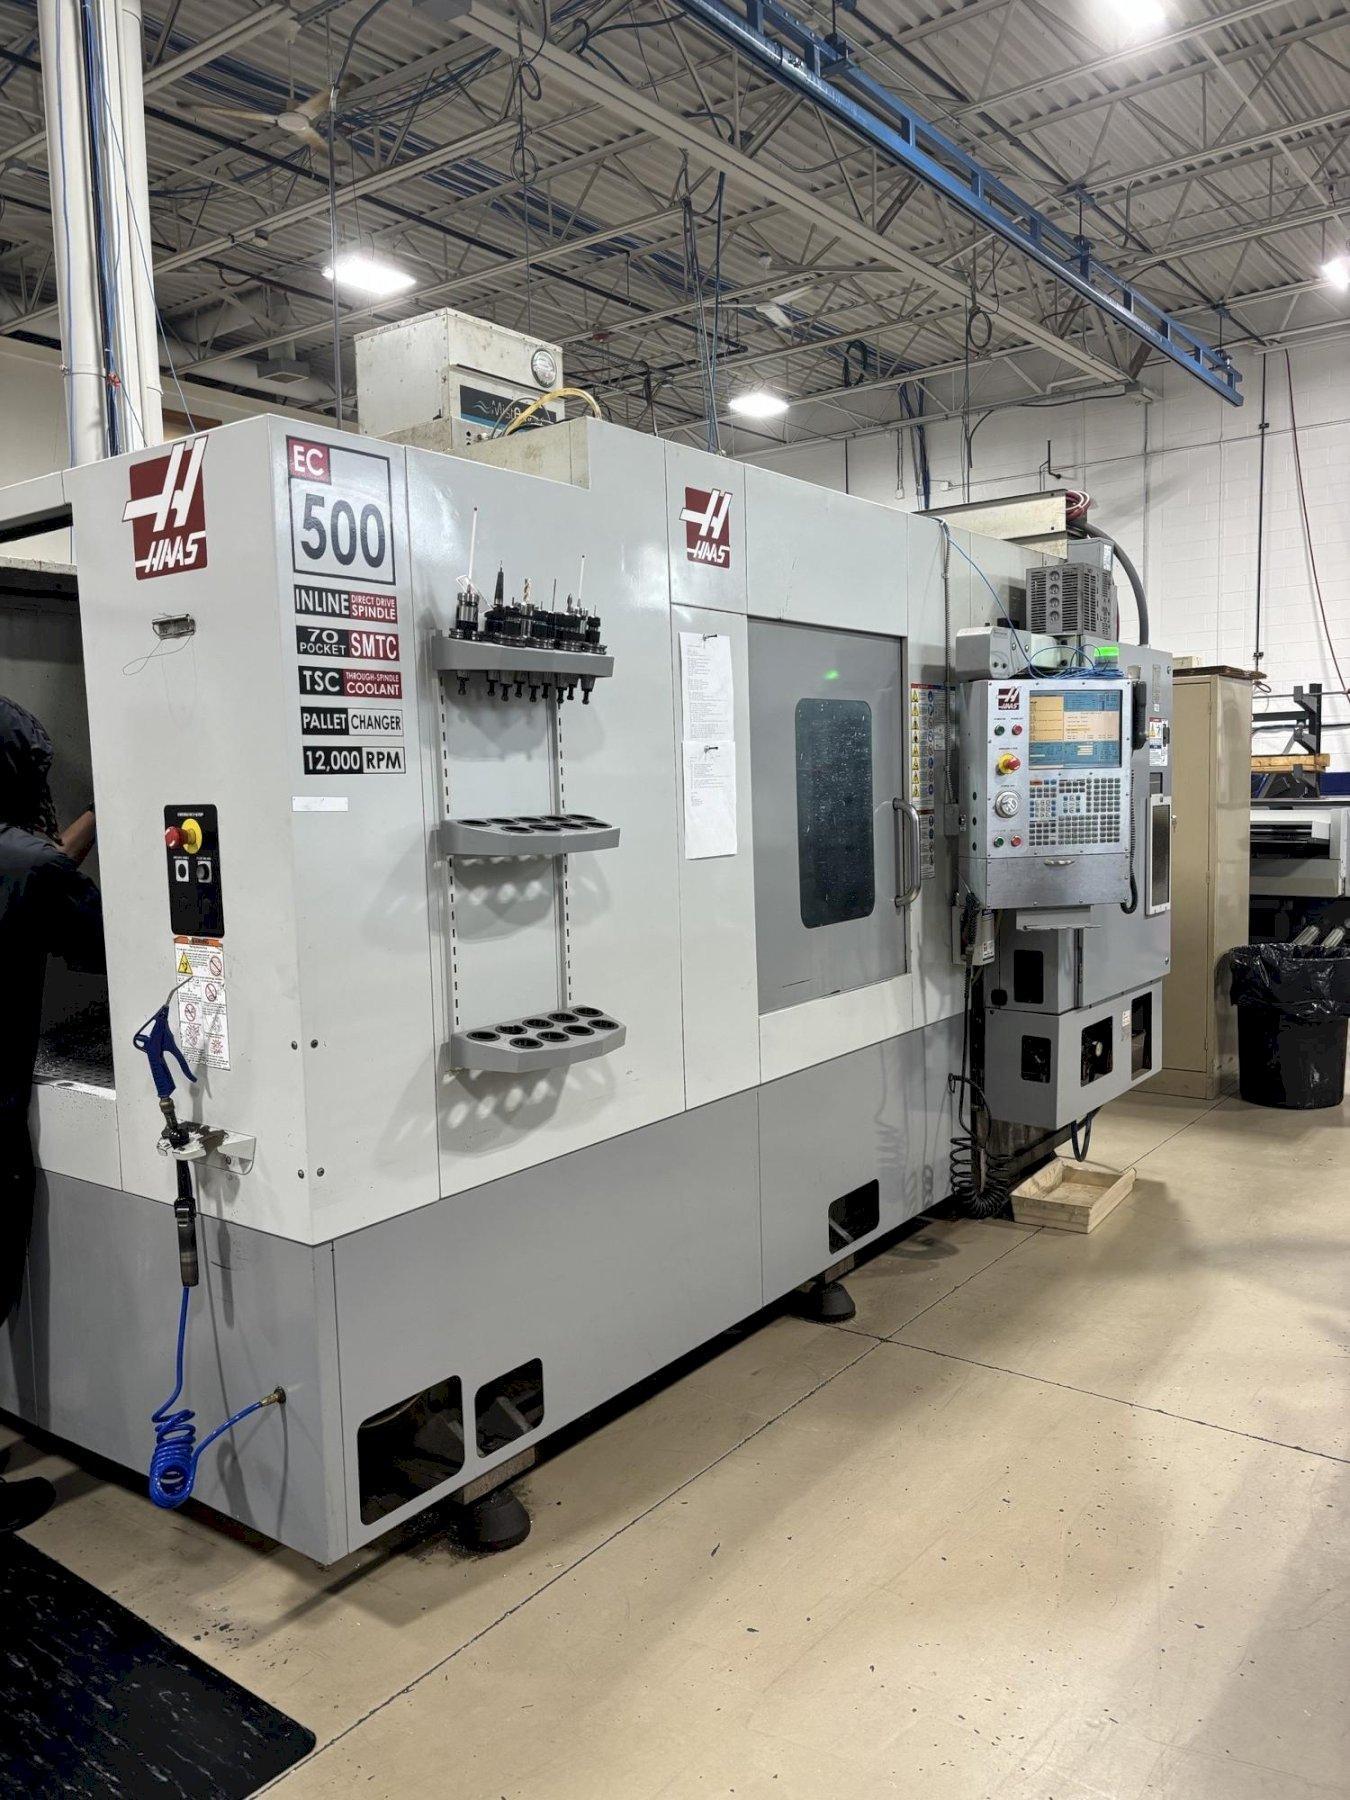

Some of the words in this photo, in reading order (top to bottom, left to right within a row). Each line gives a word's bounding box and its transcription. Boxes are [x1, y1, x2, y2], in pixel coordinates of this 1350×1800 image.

[293, 445, 325, 476] EC
[301, 493, 385, 568] 500
[135, 531, 206, 573] HAAS
[686, 540, 731, 563] HAAS
[295, 588, 350, 615] INLINE
[351, 594, 374, 605] DIRECT
[375, 598, 395, 608] DRIVE
[351, 604, 396, 620] SPINDLE
[307, 628, 339, 643] 70
[350, 632, 397, 659] SMTC
[300, 642, 346, 655] POCKET
[303, 670, 340, 692] TSC
[346, 671, 399, 683] THROUGH-SPINDLE
[346, 682, 400, 695] COOLANT
[302, 713, 347, 729] PALLET
[350, 714, 401, 730] CHANGER
[306, 750, 360, 772] 12,000
[365, 751, 401, 769] RPM
